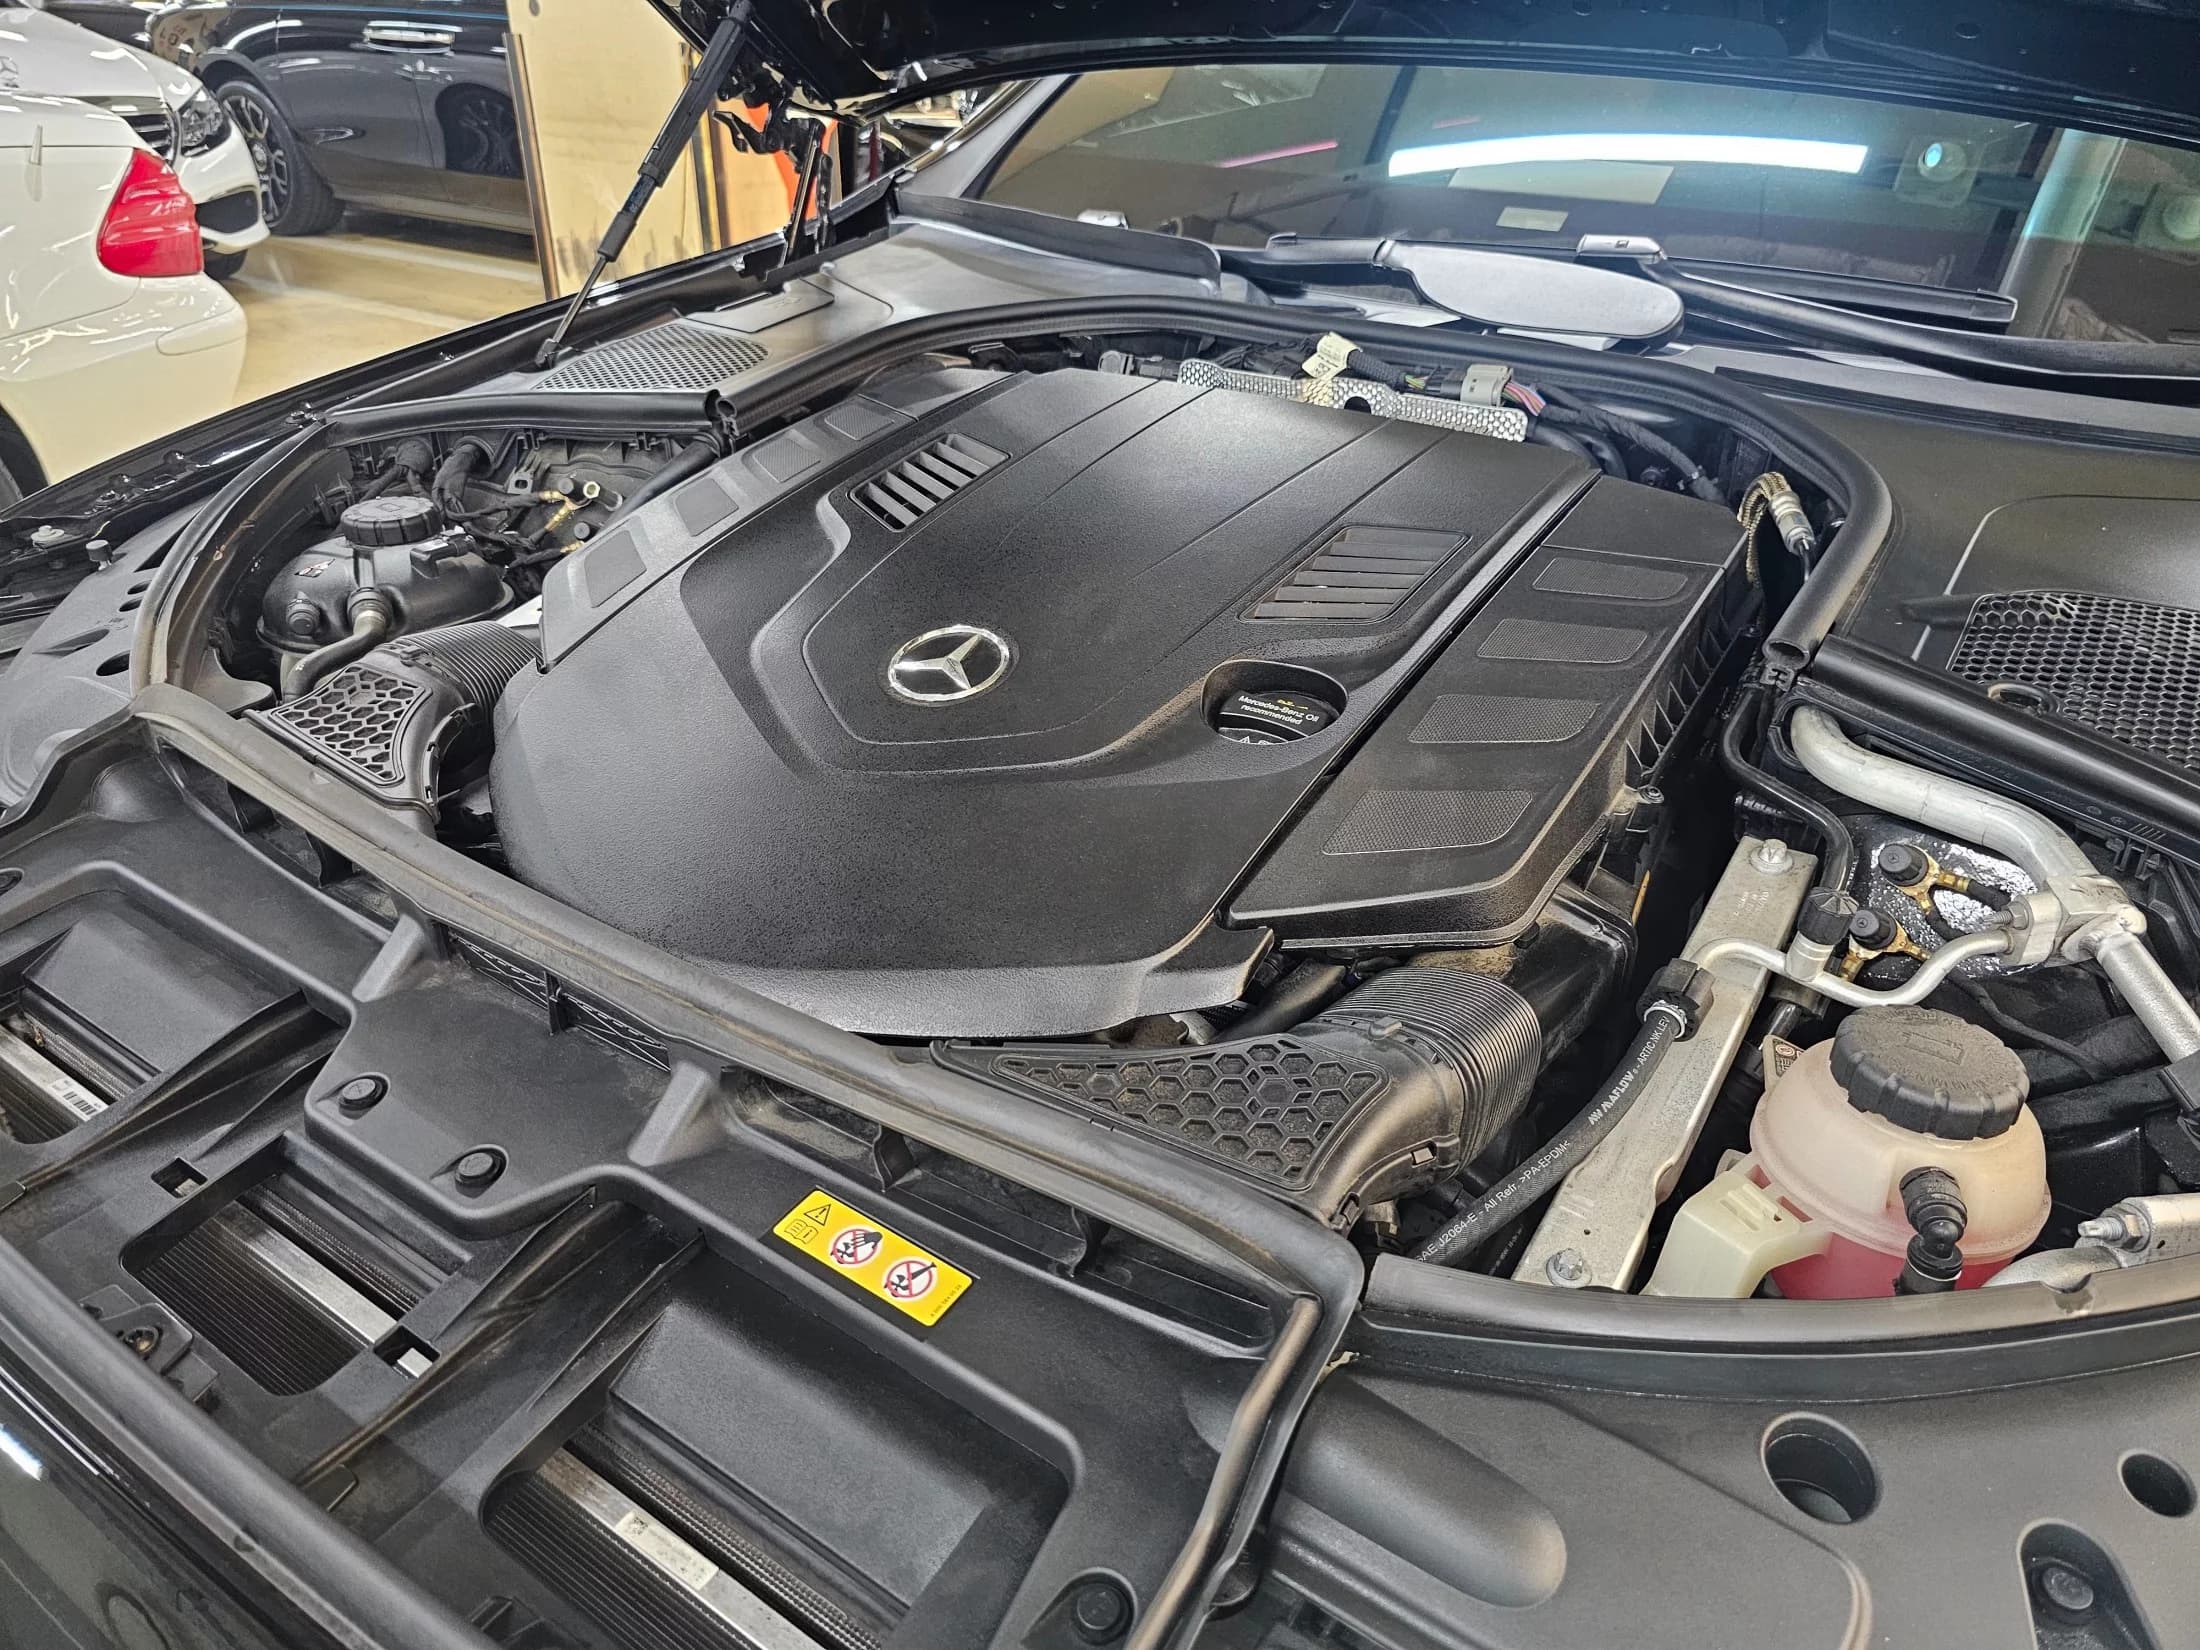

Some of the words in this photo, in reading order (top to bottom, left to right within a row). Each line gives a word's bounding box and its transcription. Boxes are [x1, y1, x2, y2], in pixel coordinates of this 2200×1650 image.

[1238, 695, 1304, 718] Mercedes-Benz
[1241, 703, 1303, 725] recommended
[1637, 1041, 1656, 1065] ARTIC
[1439, 1212, 1478, 1247] J2064-E
[1484, 1198, 1498, 1212] All
